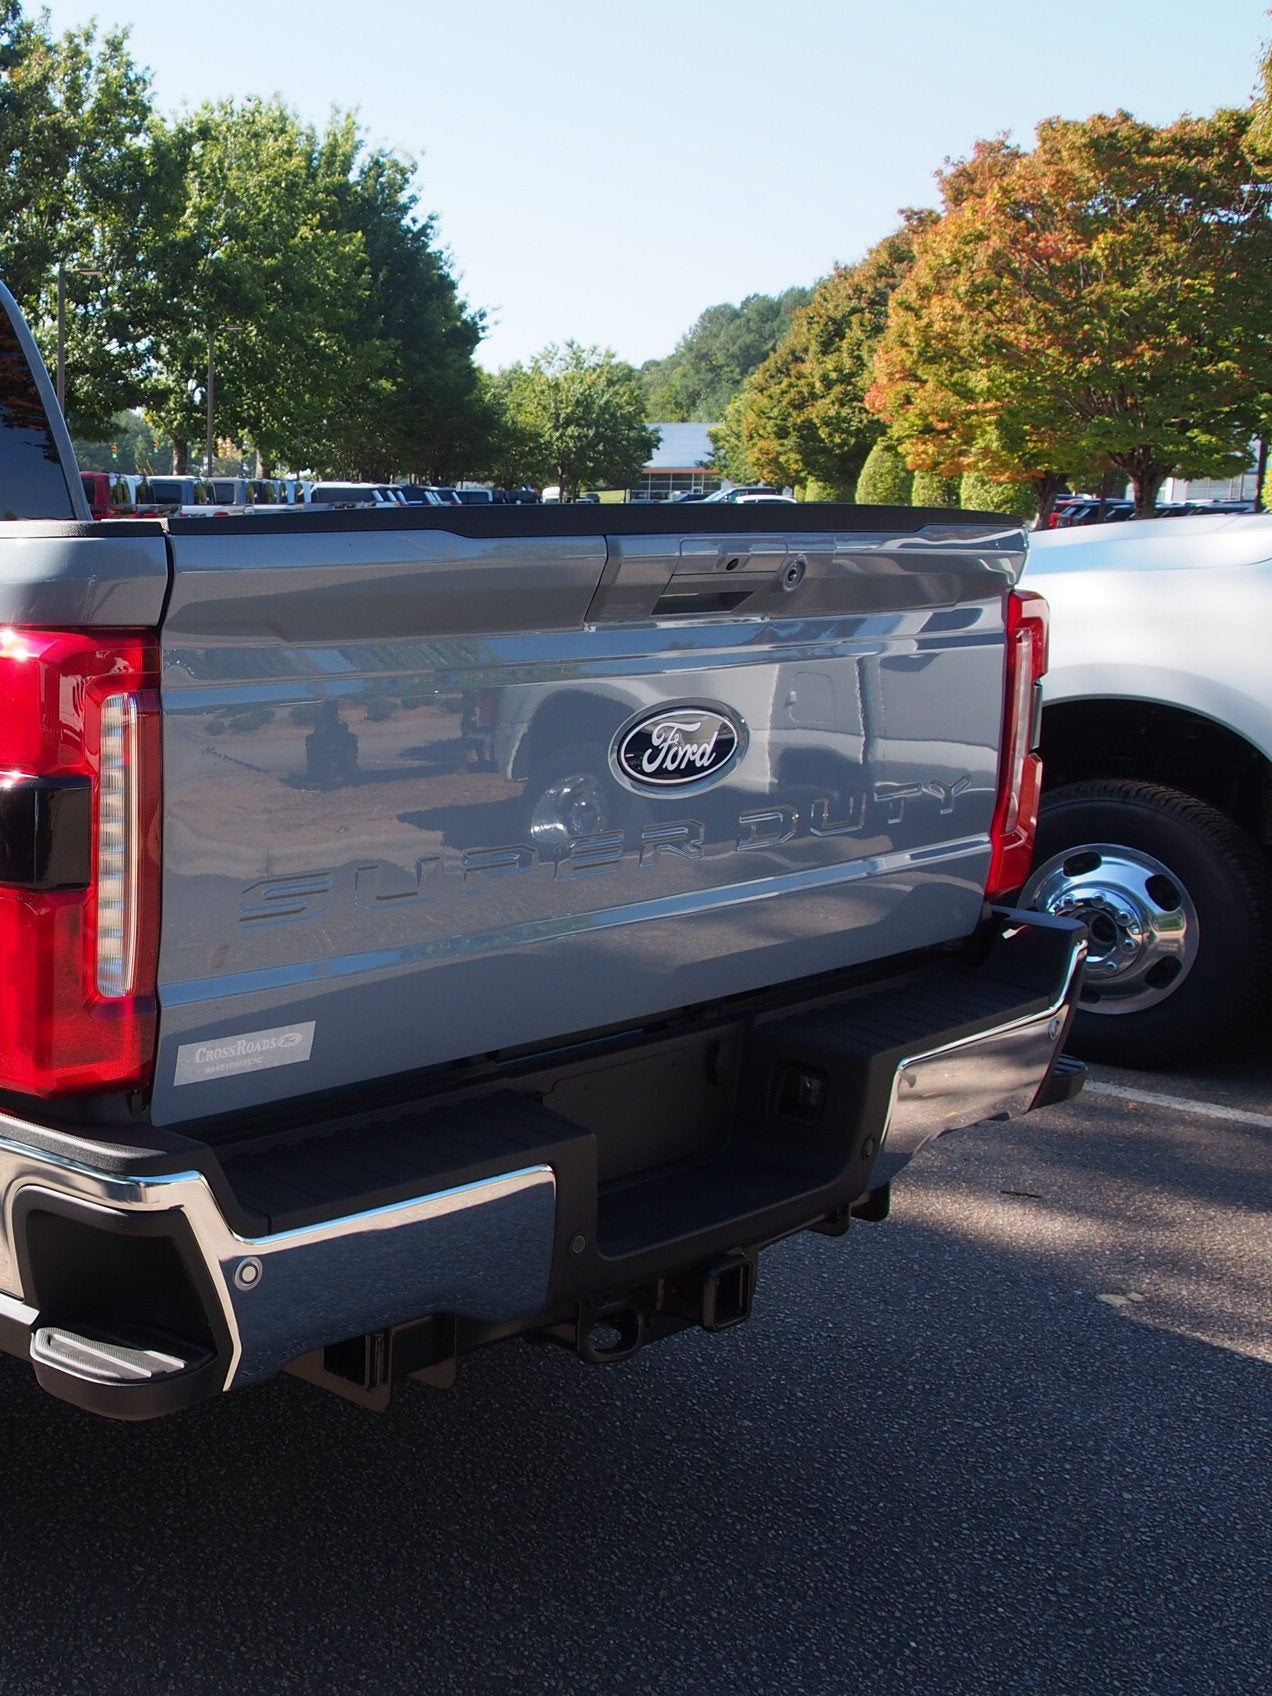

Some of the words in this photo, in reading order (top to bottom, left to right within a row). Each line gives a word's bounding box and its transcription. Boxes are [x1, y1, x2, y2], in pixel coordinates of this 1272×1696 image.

[642, 722, 718, 773] Ford
[238, 816, 705, 930] SUPER
[736, 774, 972, 852] DUTY
